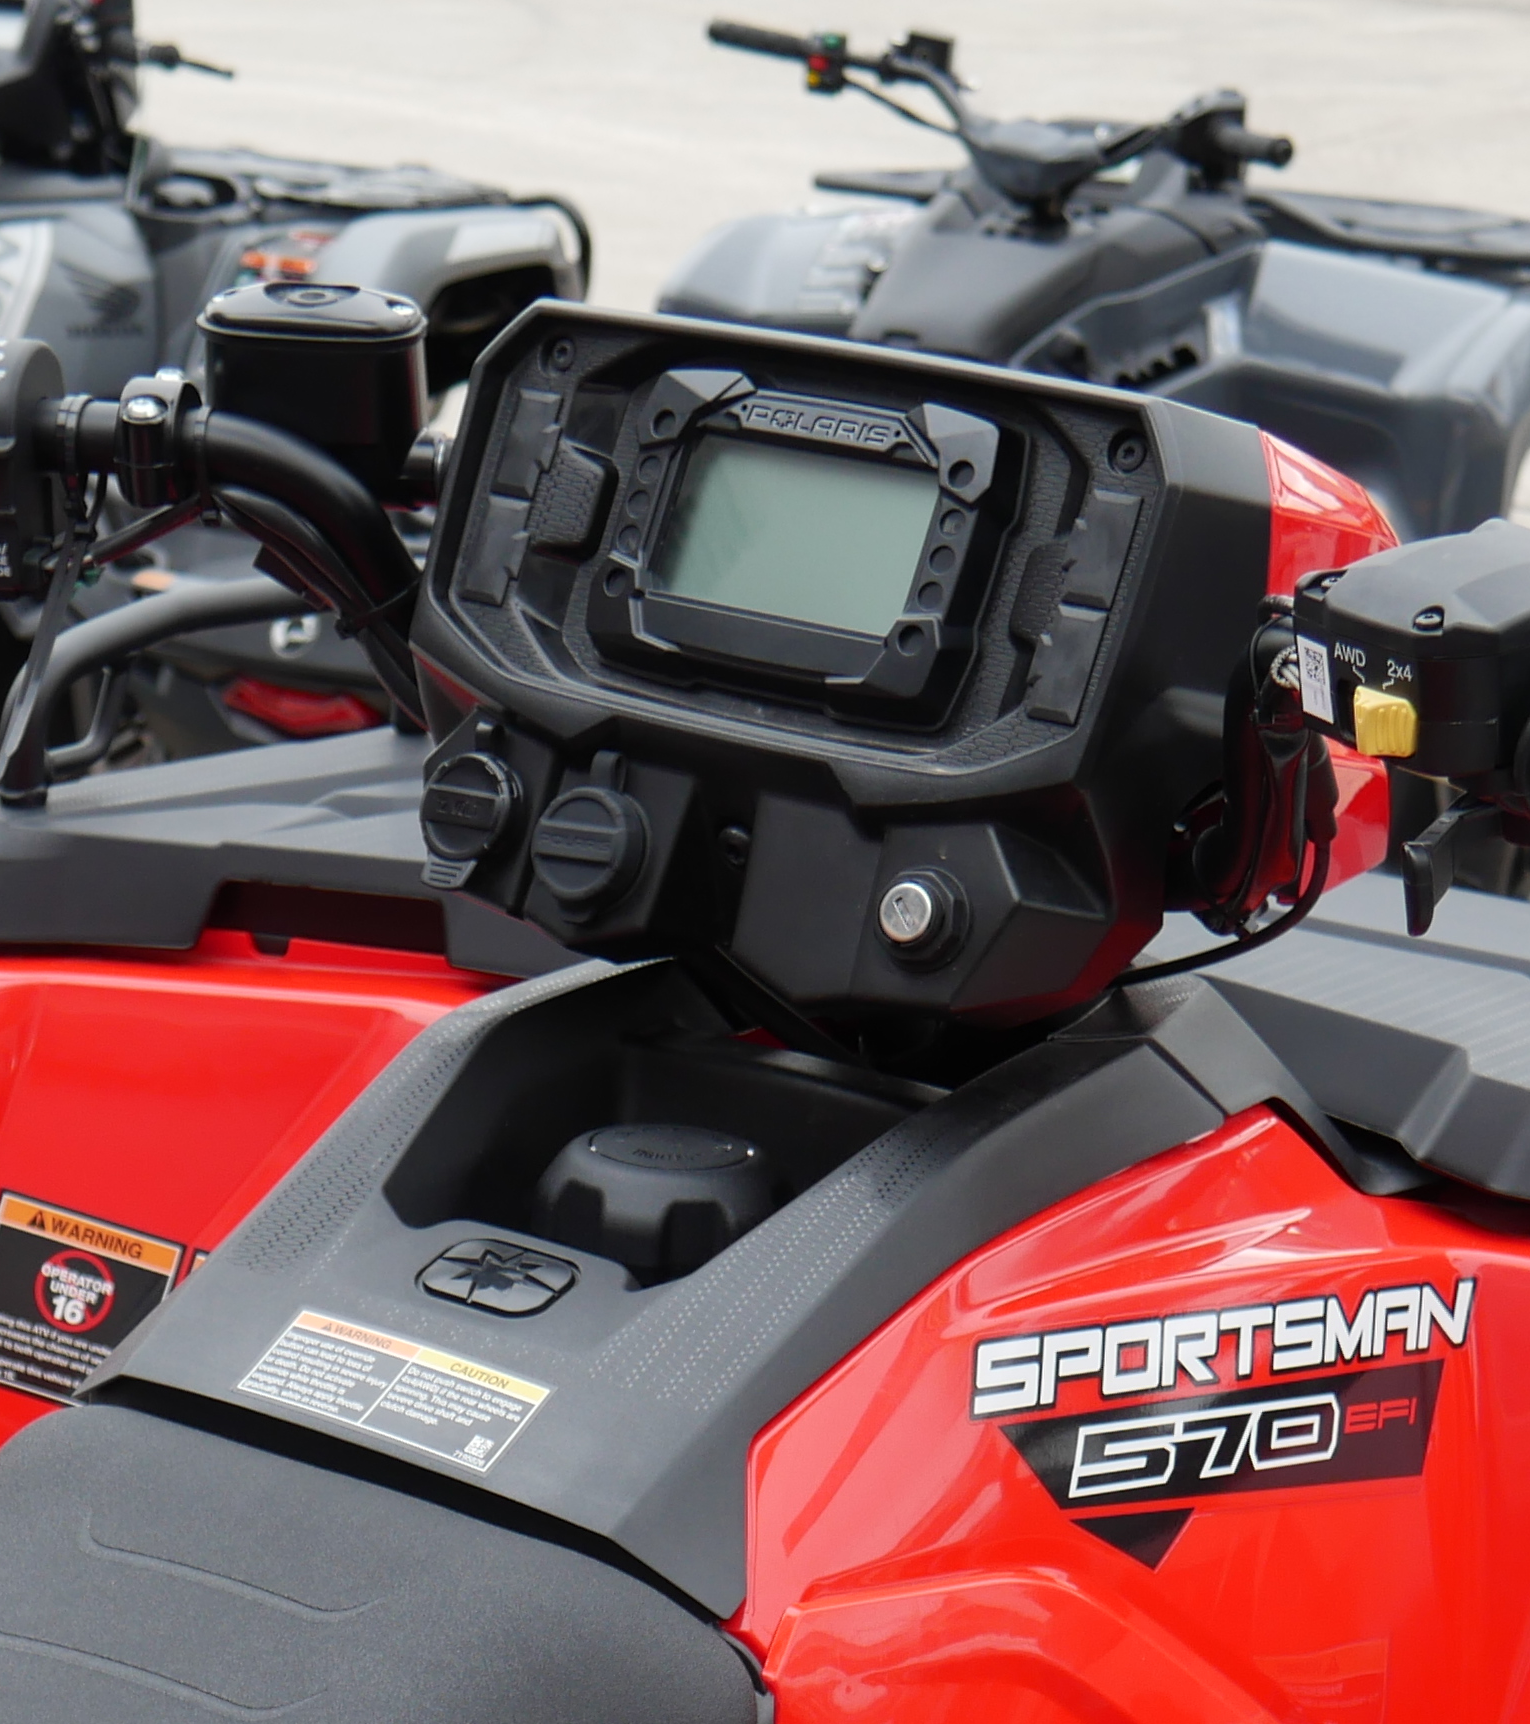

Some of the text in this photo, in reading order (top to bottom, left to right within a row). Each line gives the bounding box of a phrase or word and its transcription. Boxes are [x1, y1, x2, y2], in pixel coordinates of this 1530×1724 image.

[746, 404, 891, 444] POLARIS
[1333, 641, 1413, 683] AWD 2x4
[50, 1218, 143, 1260] WARNING
[40, 1260, 114, 1297] OPERATOR
[49, 1278, 98, 1306] UNDER
[50, 1294, 86, 1326] 16
[333, 1325, 393, 1349] WARNING
[972, 1278, 1476, 1417] SPORTSMAN
[447, 1362, 511, 1388] CAUTION
[1067, 1391, 1417, 1500] 570 EFI
